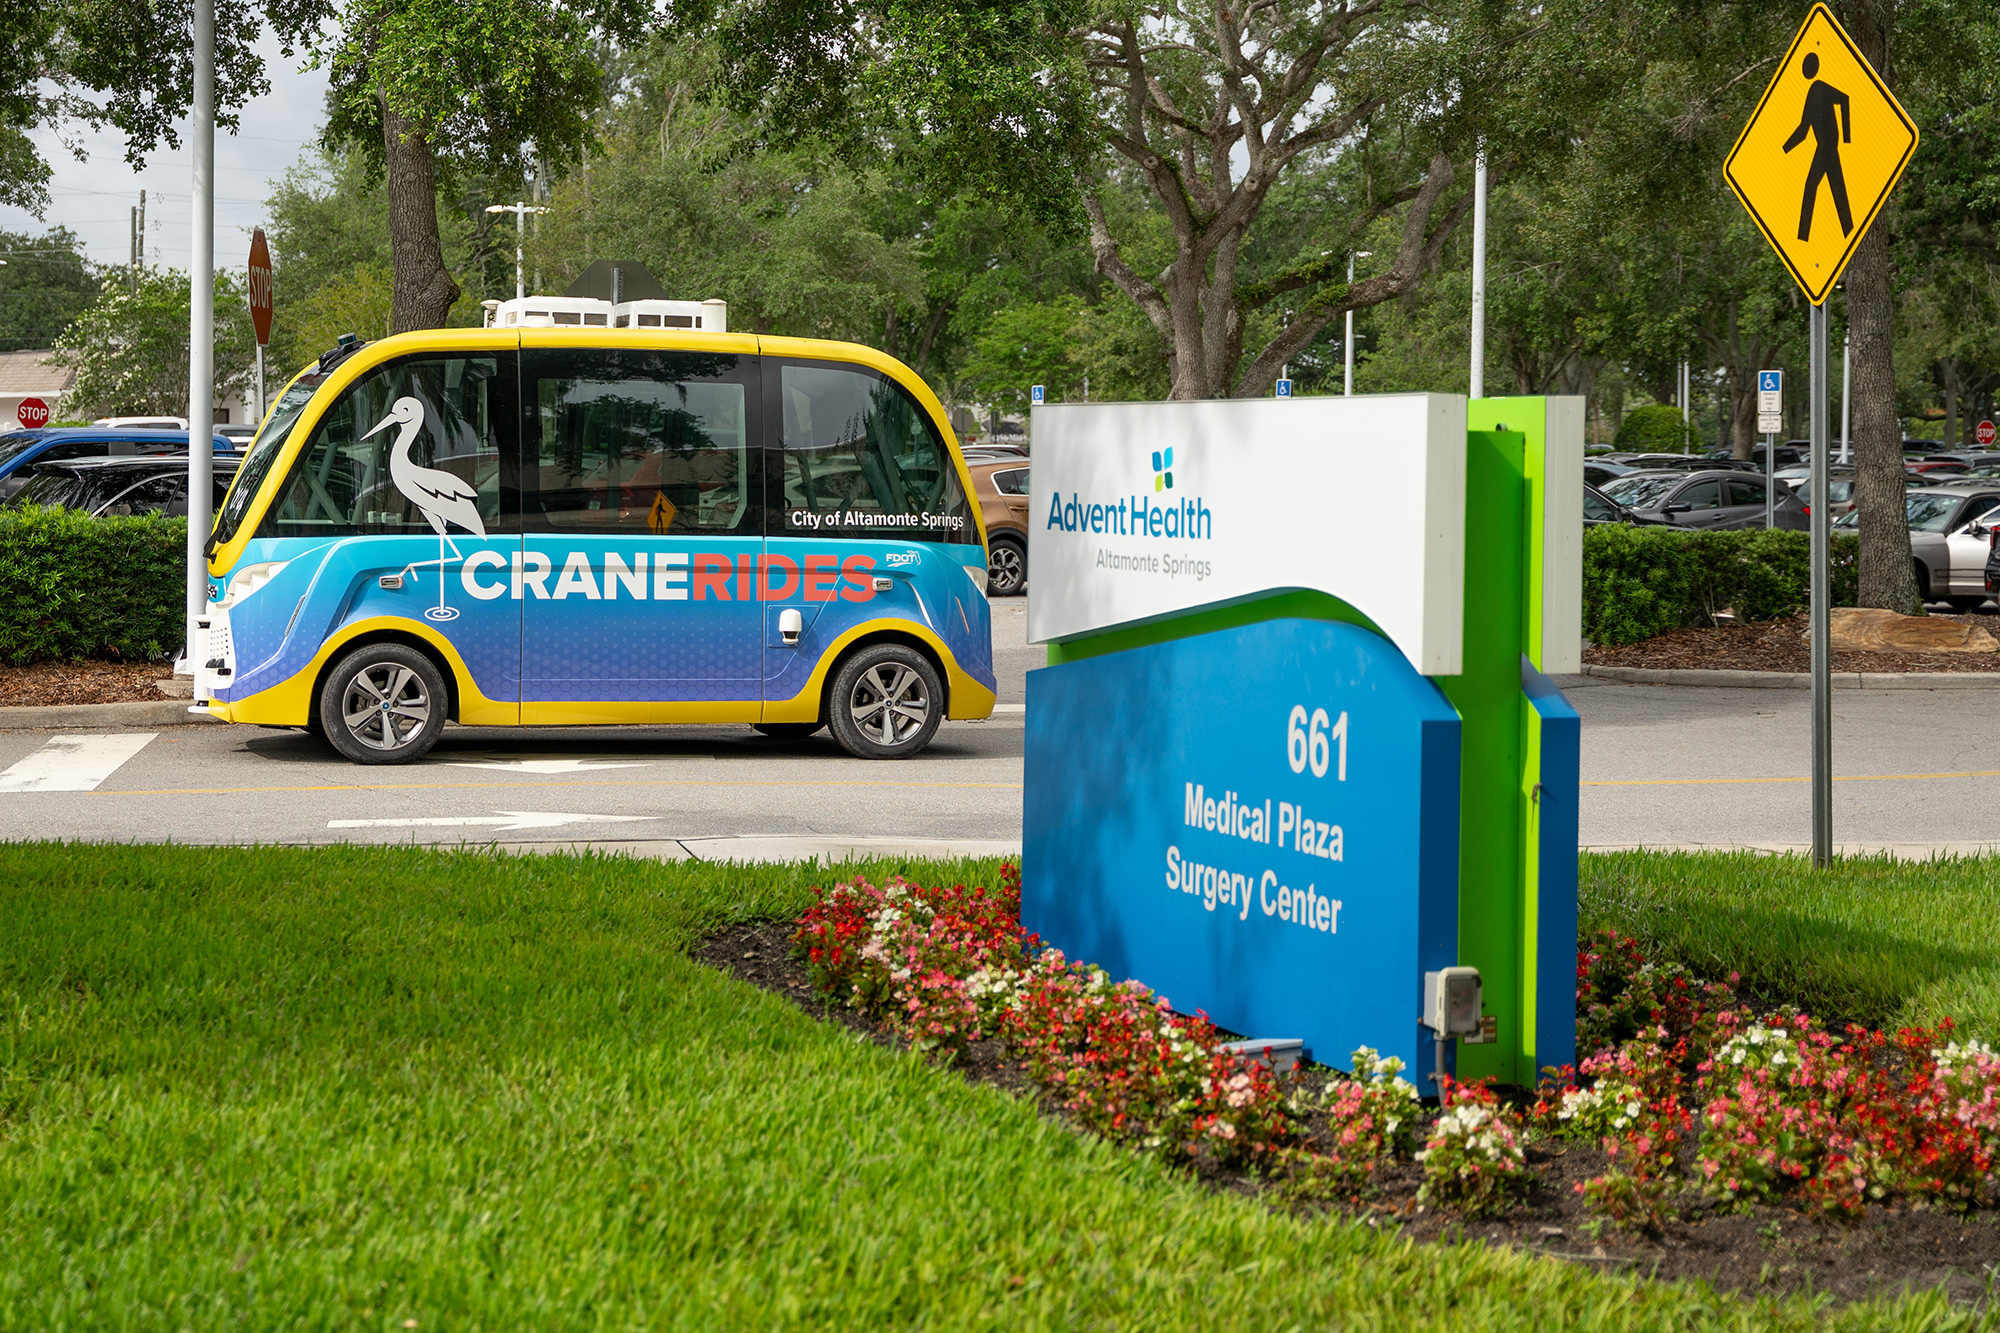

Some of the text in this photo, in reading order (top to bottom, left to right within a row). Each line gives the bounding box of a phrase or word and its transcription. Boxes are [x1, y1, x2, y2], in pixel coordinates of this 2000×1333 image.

[250, 265, 272, 309] STOP
[19, 405, 48, 421] STOP
[1978, 428, 1995, 438] STOP
[791, 510, 964, 531] City of Altamonte Springs
[1046, 491, 1212, 540] AdventHealth
[886, 553, 915, 563] FDOT
[1096, 548, 1212, 581] Altamonte Springs
[1287, 704, 1348, 782] 661
[1184, 782, 1344, 863] Medical Plaza
[1165, 845, 1343, 935] Surgery Center
